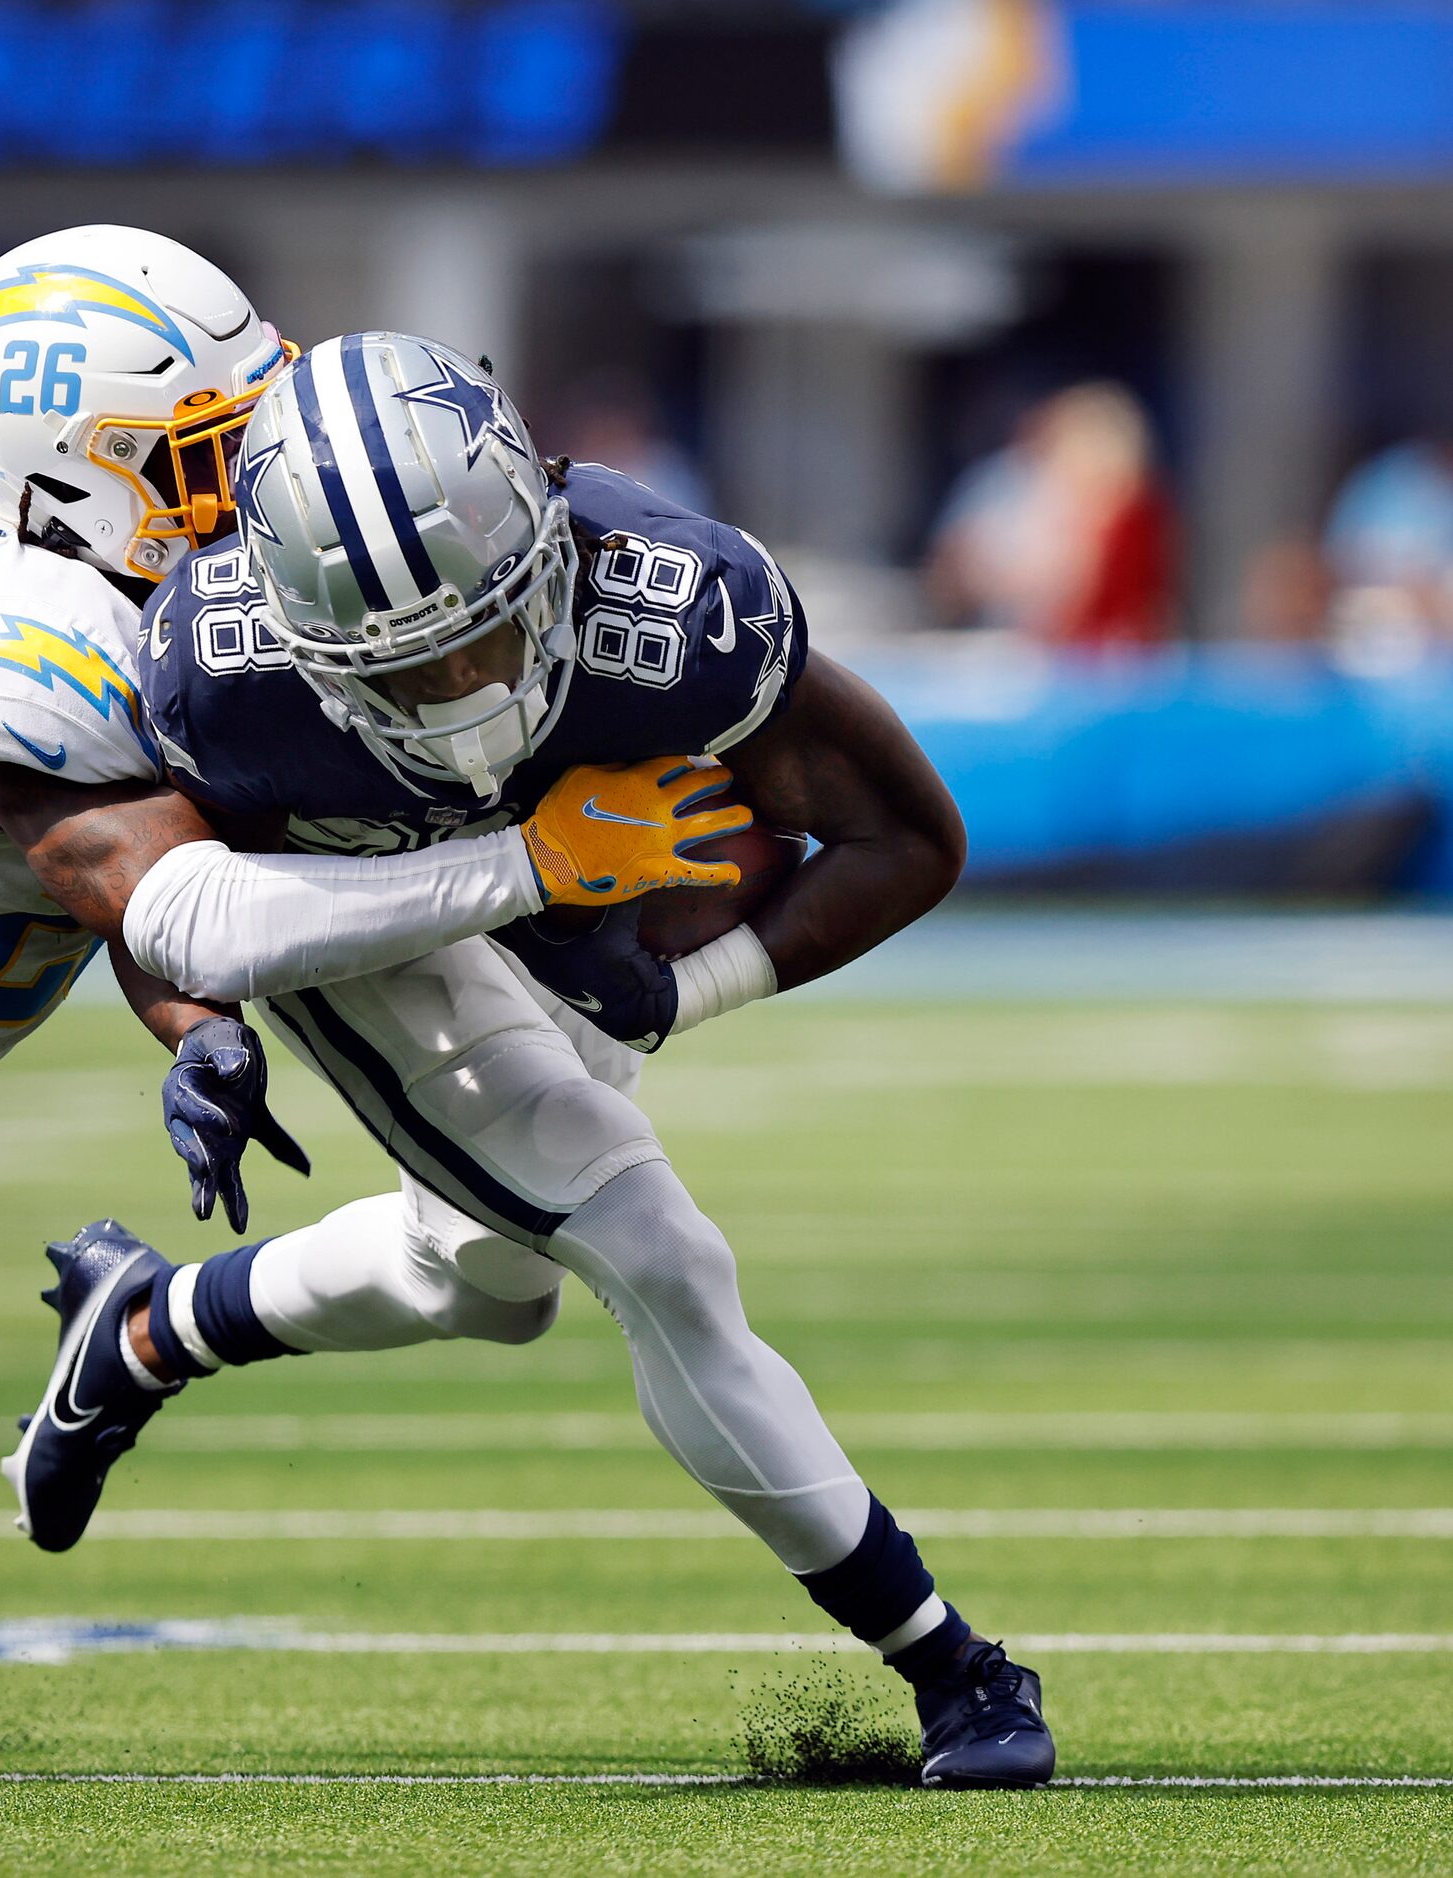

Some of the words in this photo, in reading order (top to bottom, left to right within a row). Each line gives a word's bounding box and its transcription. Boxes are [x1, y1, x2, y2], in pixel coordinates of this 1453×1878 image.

[0, 340, 87, 417] 26
[191, 546, 295, 677] 88
[389, 603, 439, 627] COWBOYS
[577, 529, 703, 691] 88
[622, 878, 660, 895] LOS
